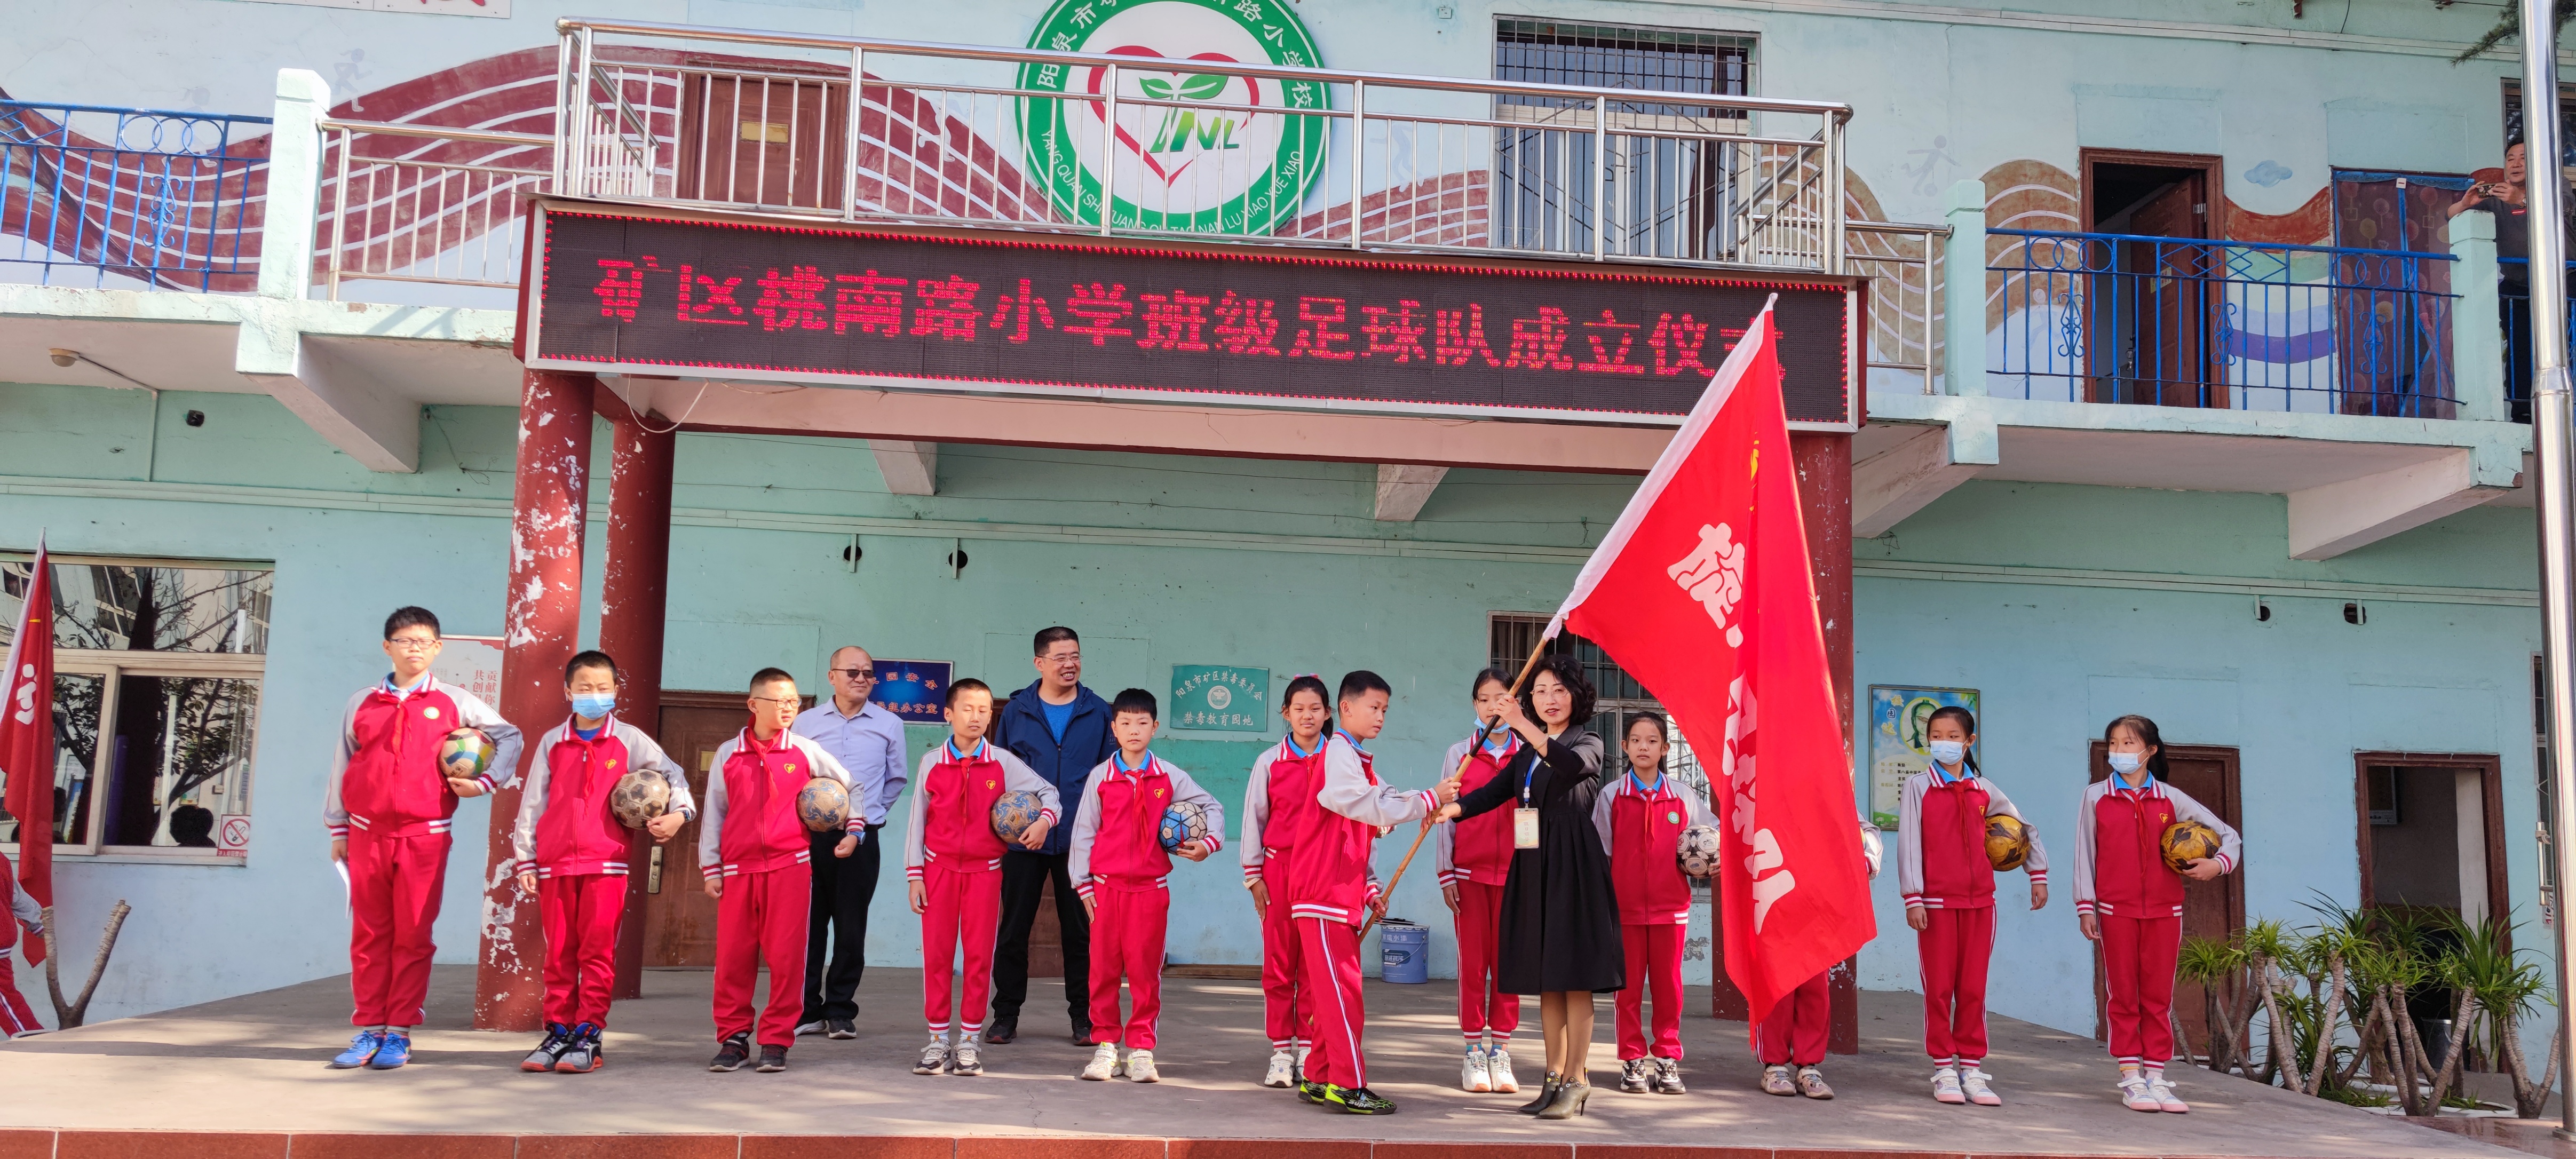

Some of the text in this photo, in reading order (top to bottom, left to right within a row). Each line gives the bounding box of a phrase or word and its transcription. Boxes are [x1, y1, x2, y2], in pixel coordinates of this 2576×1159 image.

[1225, 212, 1242, 229] LU
[874, 671, 938, 690] 园安全
[1175, 671, 1263, 701] 阳泉市矿区禁毒委员会
[1184, 711, 1254, 727] 禁毒教育园地
